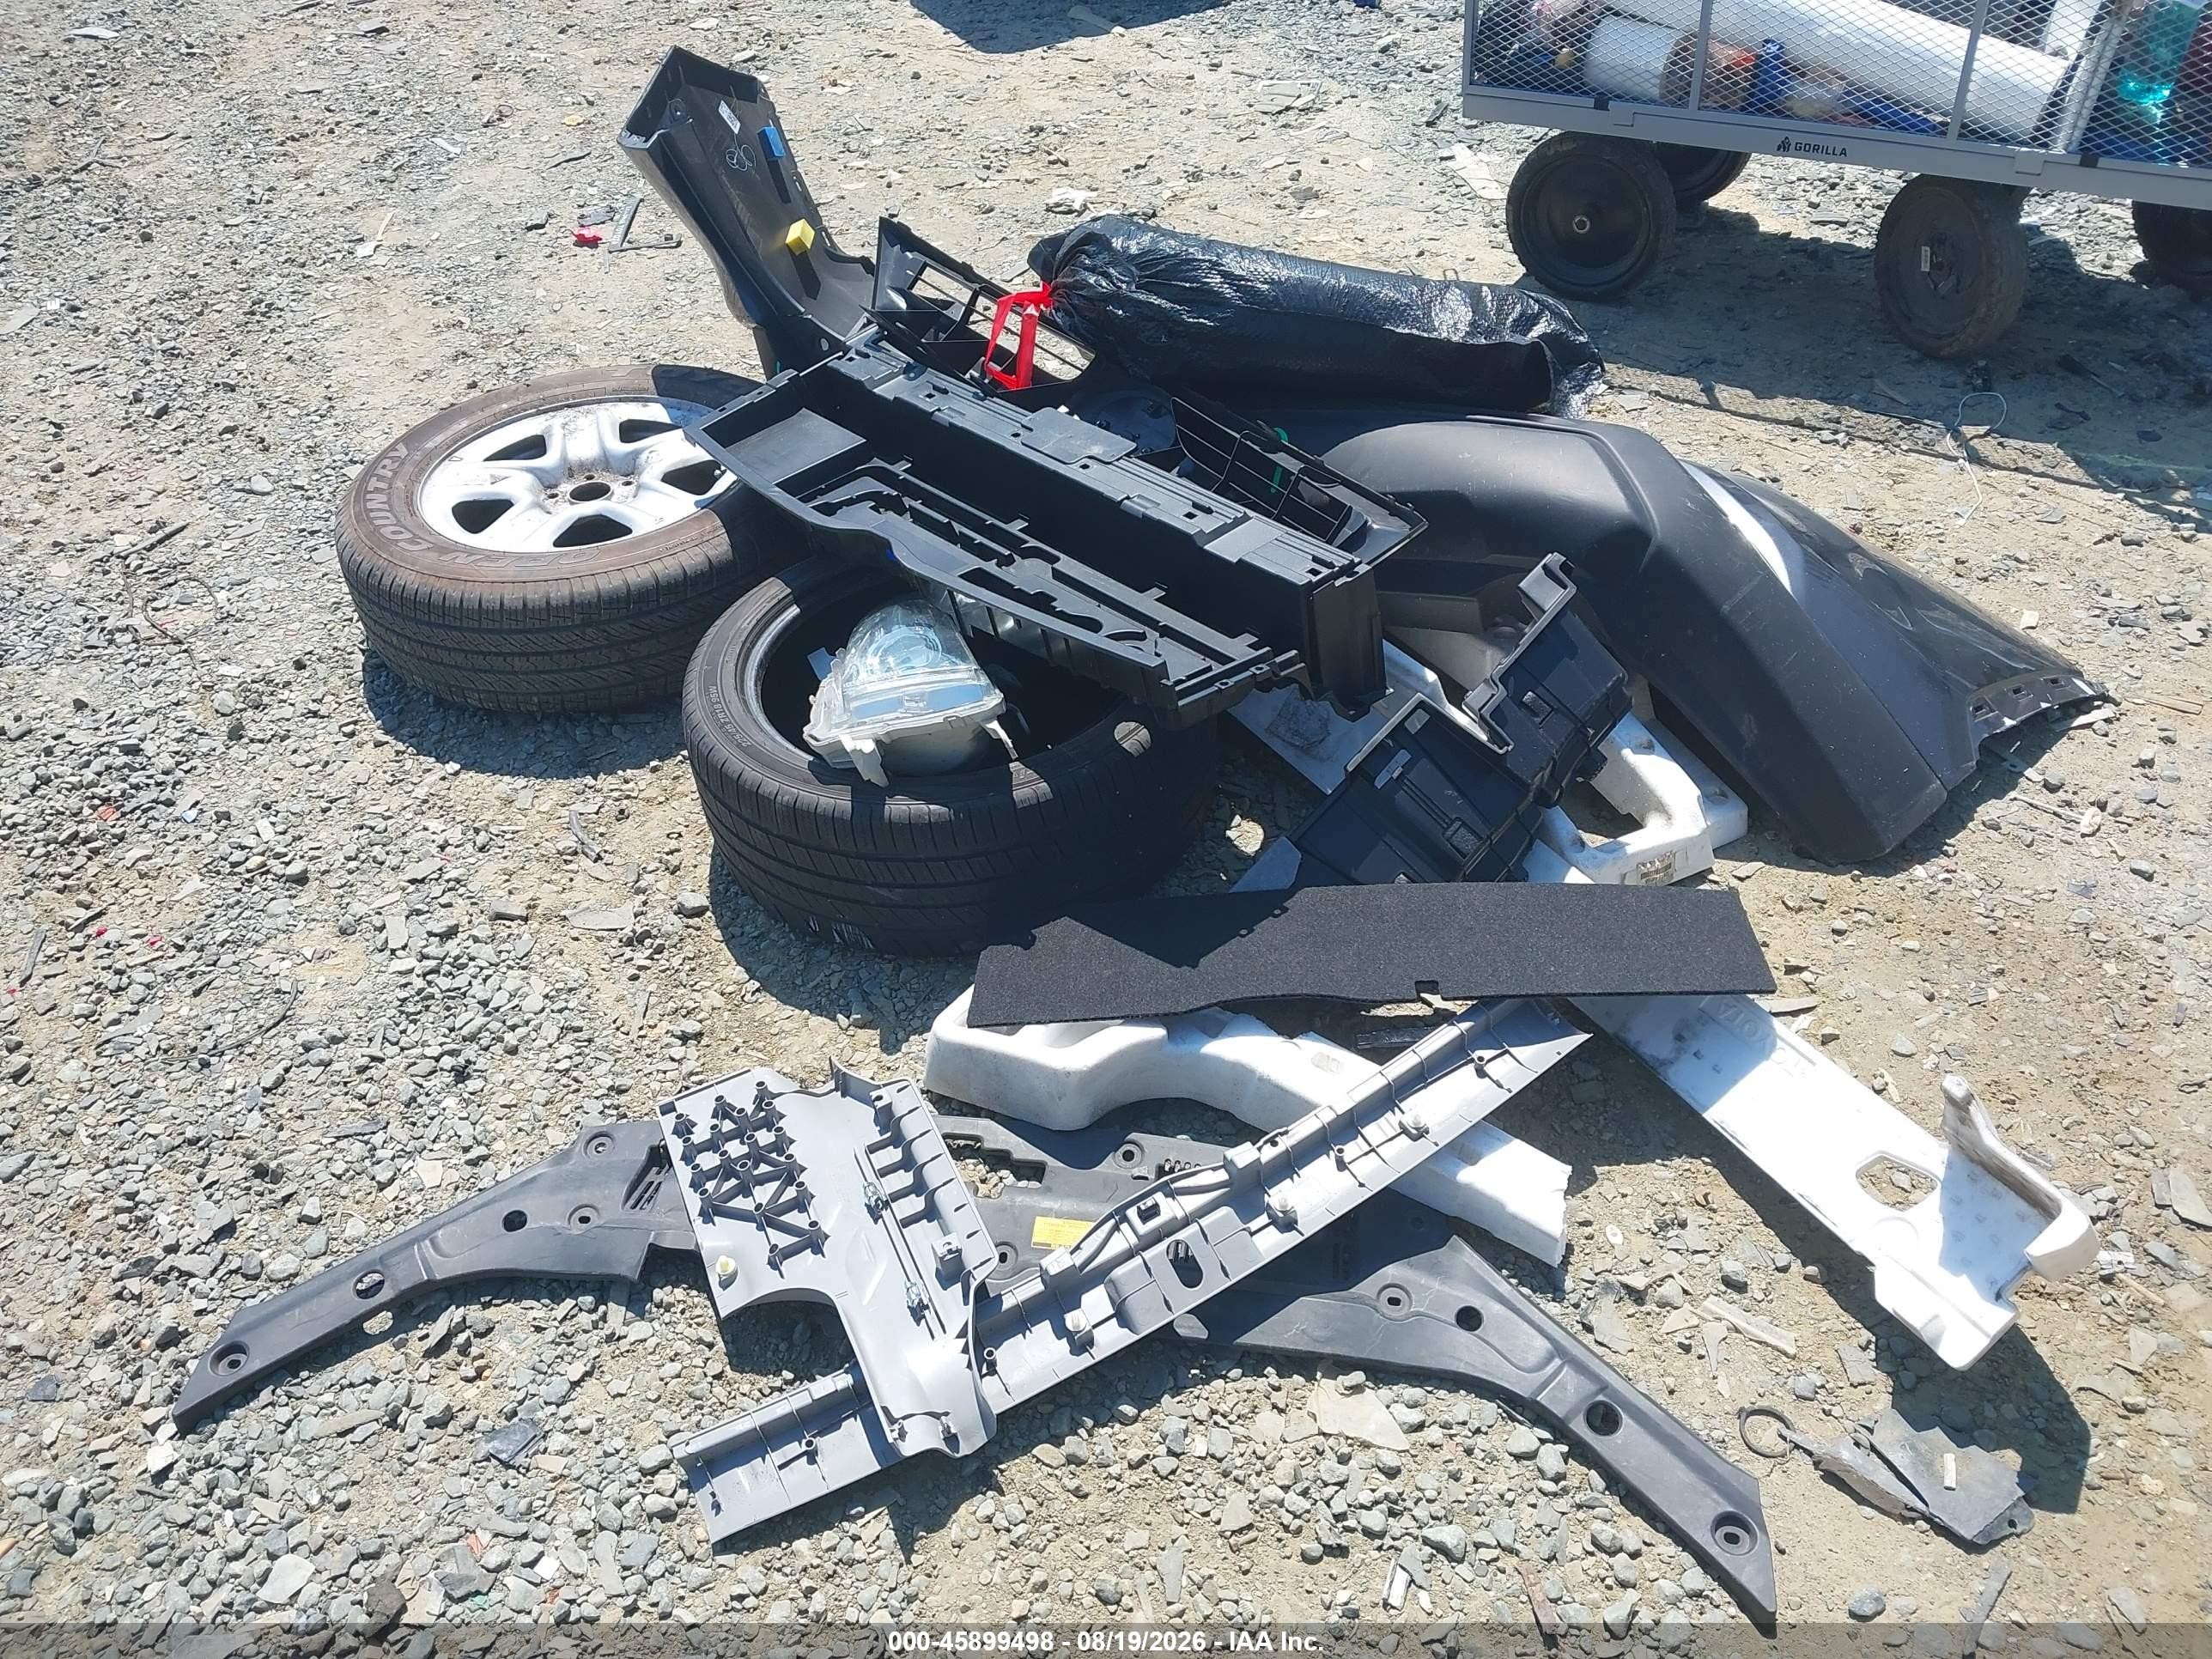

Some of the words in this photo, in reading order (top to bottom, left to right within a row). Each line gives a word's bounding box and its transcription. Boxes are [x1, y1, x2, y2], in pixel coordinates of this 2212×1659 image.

[1795, 142, 1847, 157] GORILLA
[364, 442, 434, 551] COUNTRY
[439, 546, 601, 568] OPEN
[708, 685, 720, 702] 95W
[714, 703, 730, 723] ZR18
[726, 724, 752, 747] 225/45
